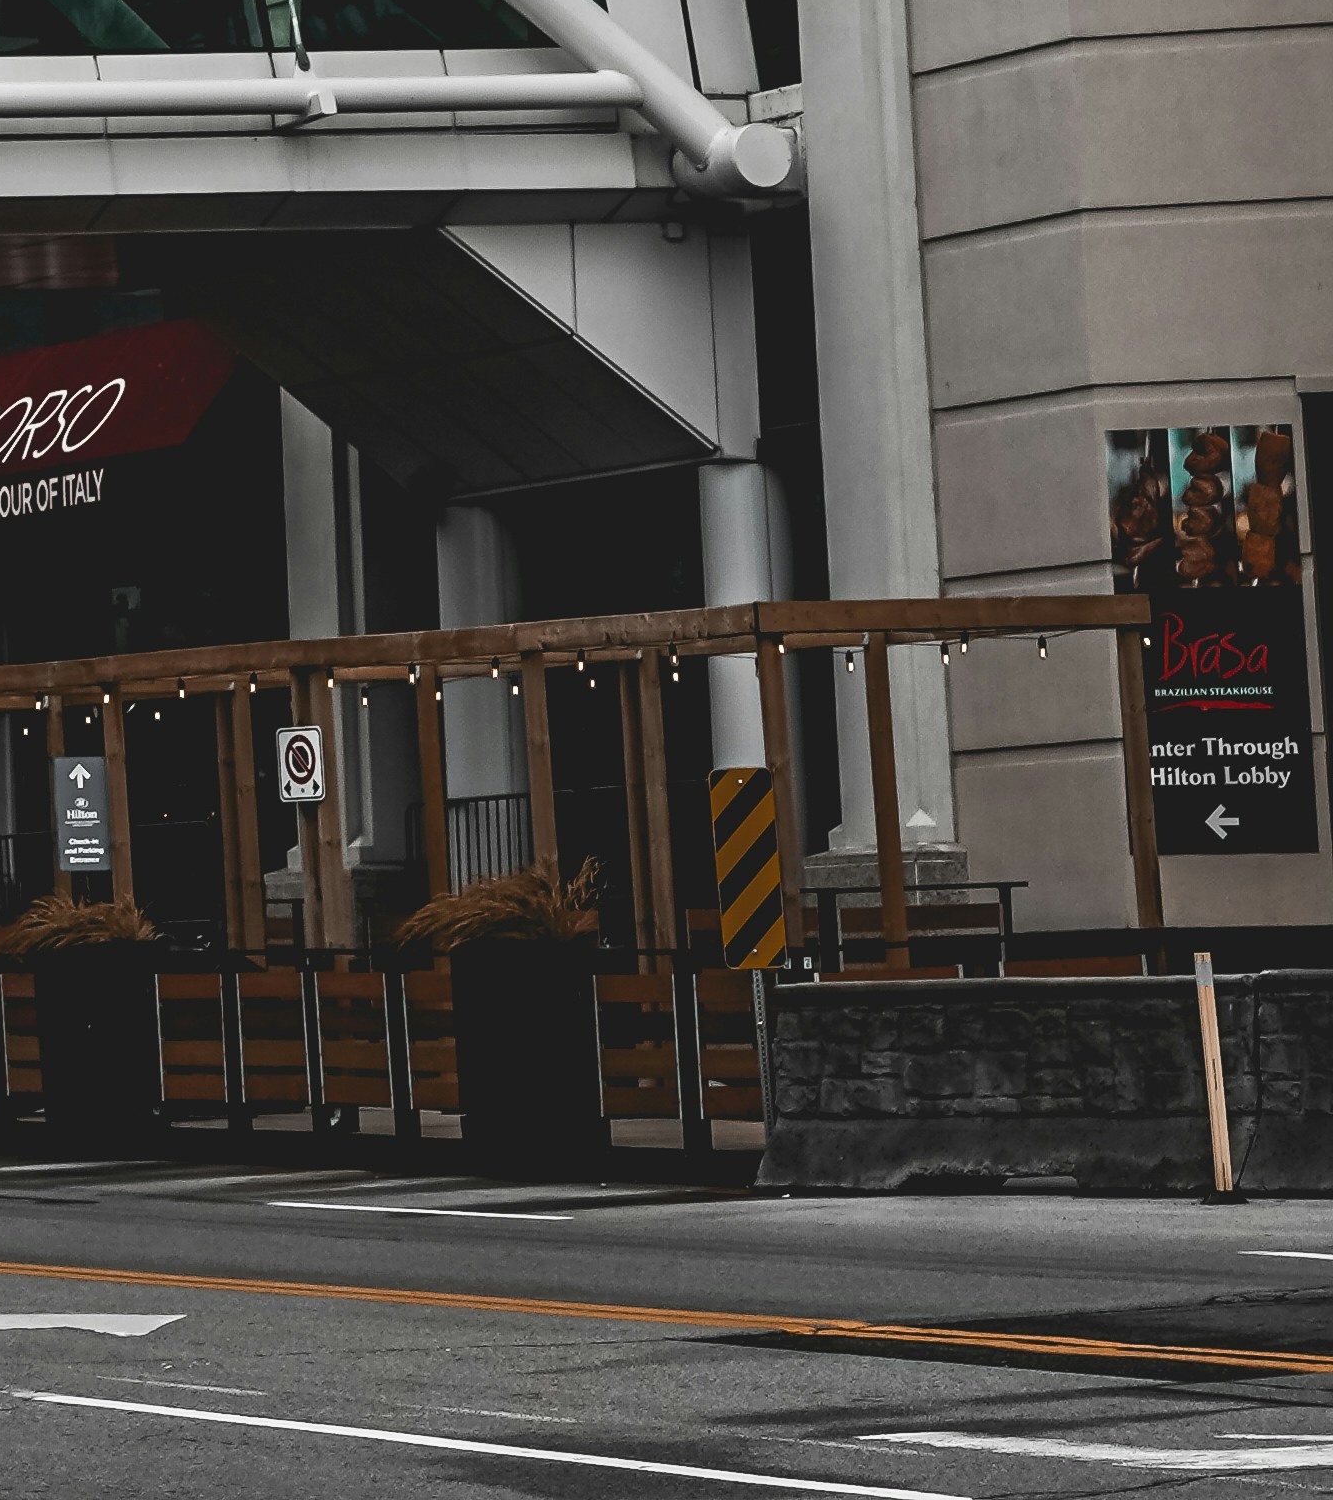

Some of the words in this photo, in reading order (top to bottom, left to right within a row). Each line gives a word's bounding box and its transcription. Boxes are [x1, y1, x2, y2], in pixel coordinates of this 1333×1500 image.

[36, 477, 59, 512] OF
[62, 467, 105, 507] ITALY
[1154, 687, 1208, 697] BRAZILIAN
[1209, 686, 1274, 696] STEAKHOUSE
[1148, 742, 1196, 758] nter
[1201, 735, 1300, 760] Through
[1150, 766, 1217, 787] Hilton
[1223, 765, 1292, 789] Lobby
[67, 809, 98, 819] Hilton
